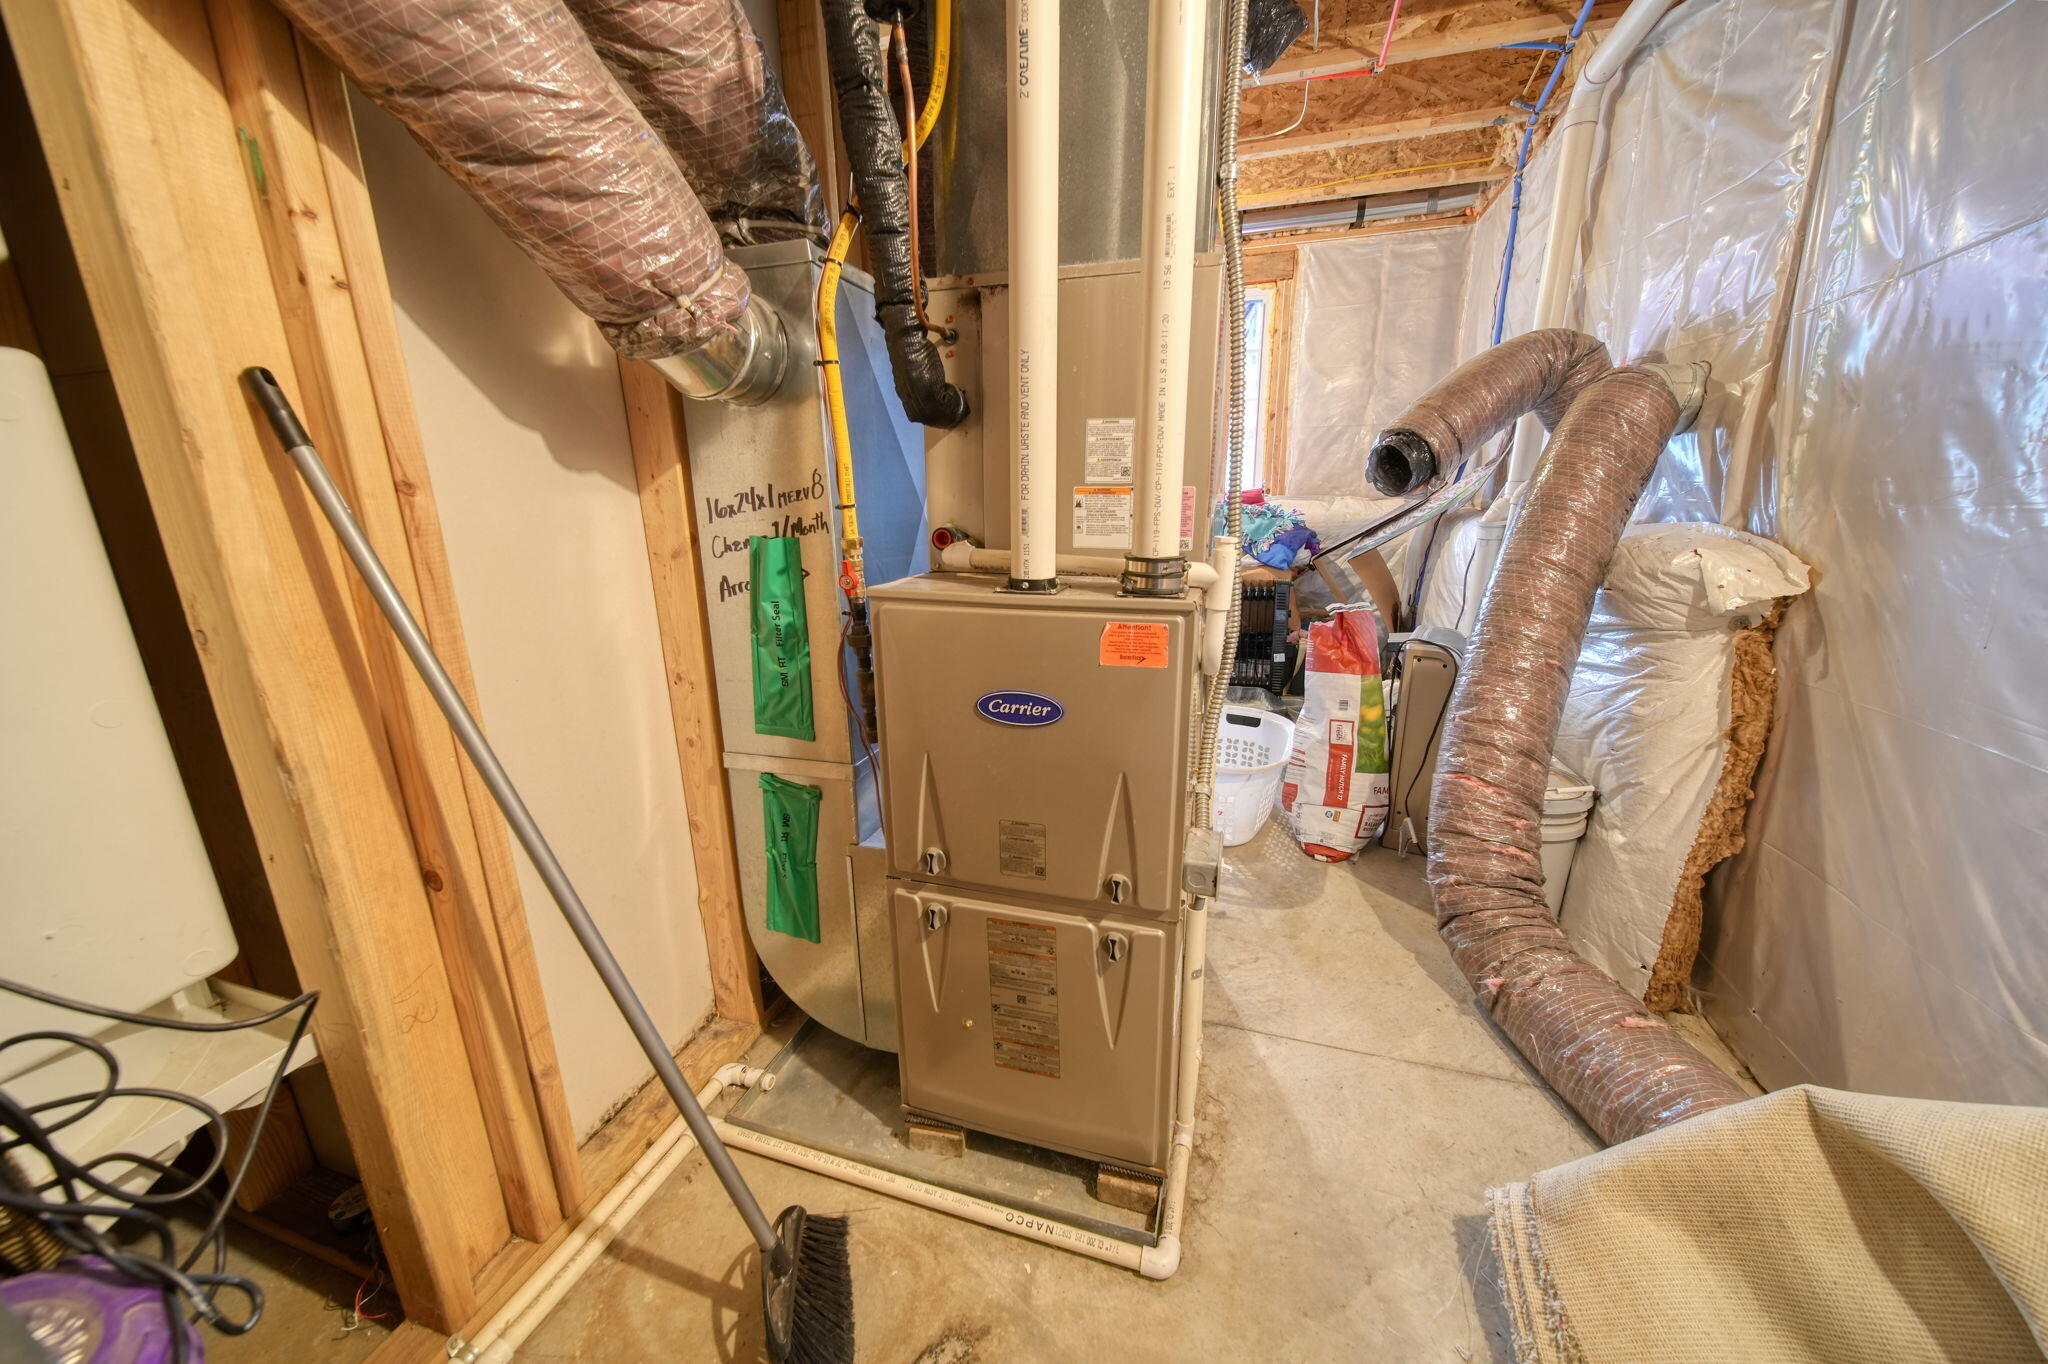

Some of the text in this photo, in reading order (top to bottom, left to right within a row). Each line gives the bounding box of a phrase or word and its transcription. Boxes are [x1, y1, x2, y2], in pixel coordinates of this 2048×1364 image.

[1020, 349, 1030, 373] ONLY
[1020, 375, 1030, 400] VENT
[1159, 387, 1167, 397] IN
[1020, 401, 1030, 420] AND
[1020, 422, 1030, 451] WASTE
[1020, 454, 1030, 481] DRAIN
[1020, 482, 1030, 501] FOR
[771, 600, 781, 621] Seal
[988, 699, 1052, 717] Carrier
[1339, 754, 1349, 775] FAMILY
[1338, 775, 1346, 795] HUTCH
[1004, 1210, 1054, 1235] NAPCO
